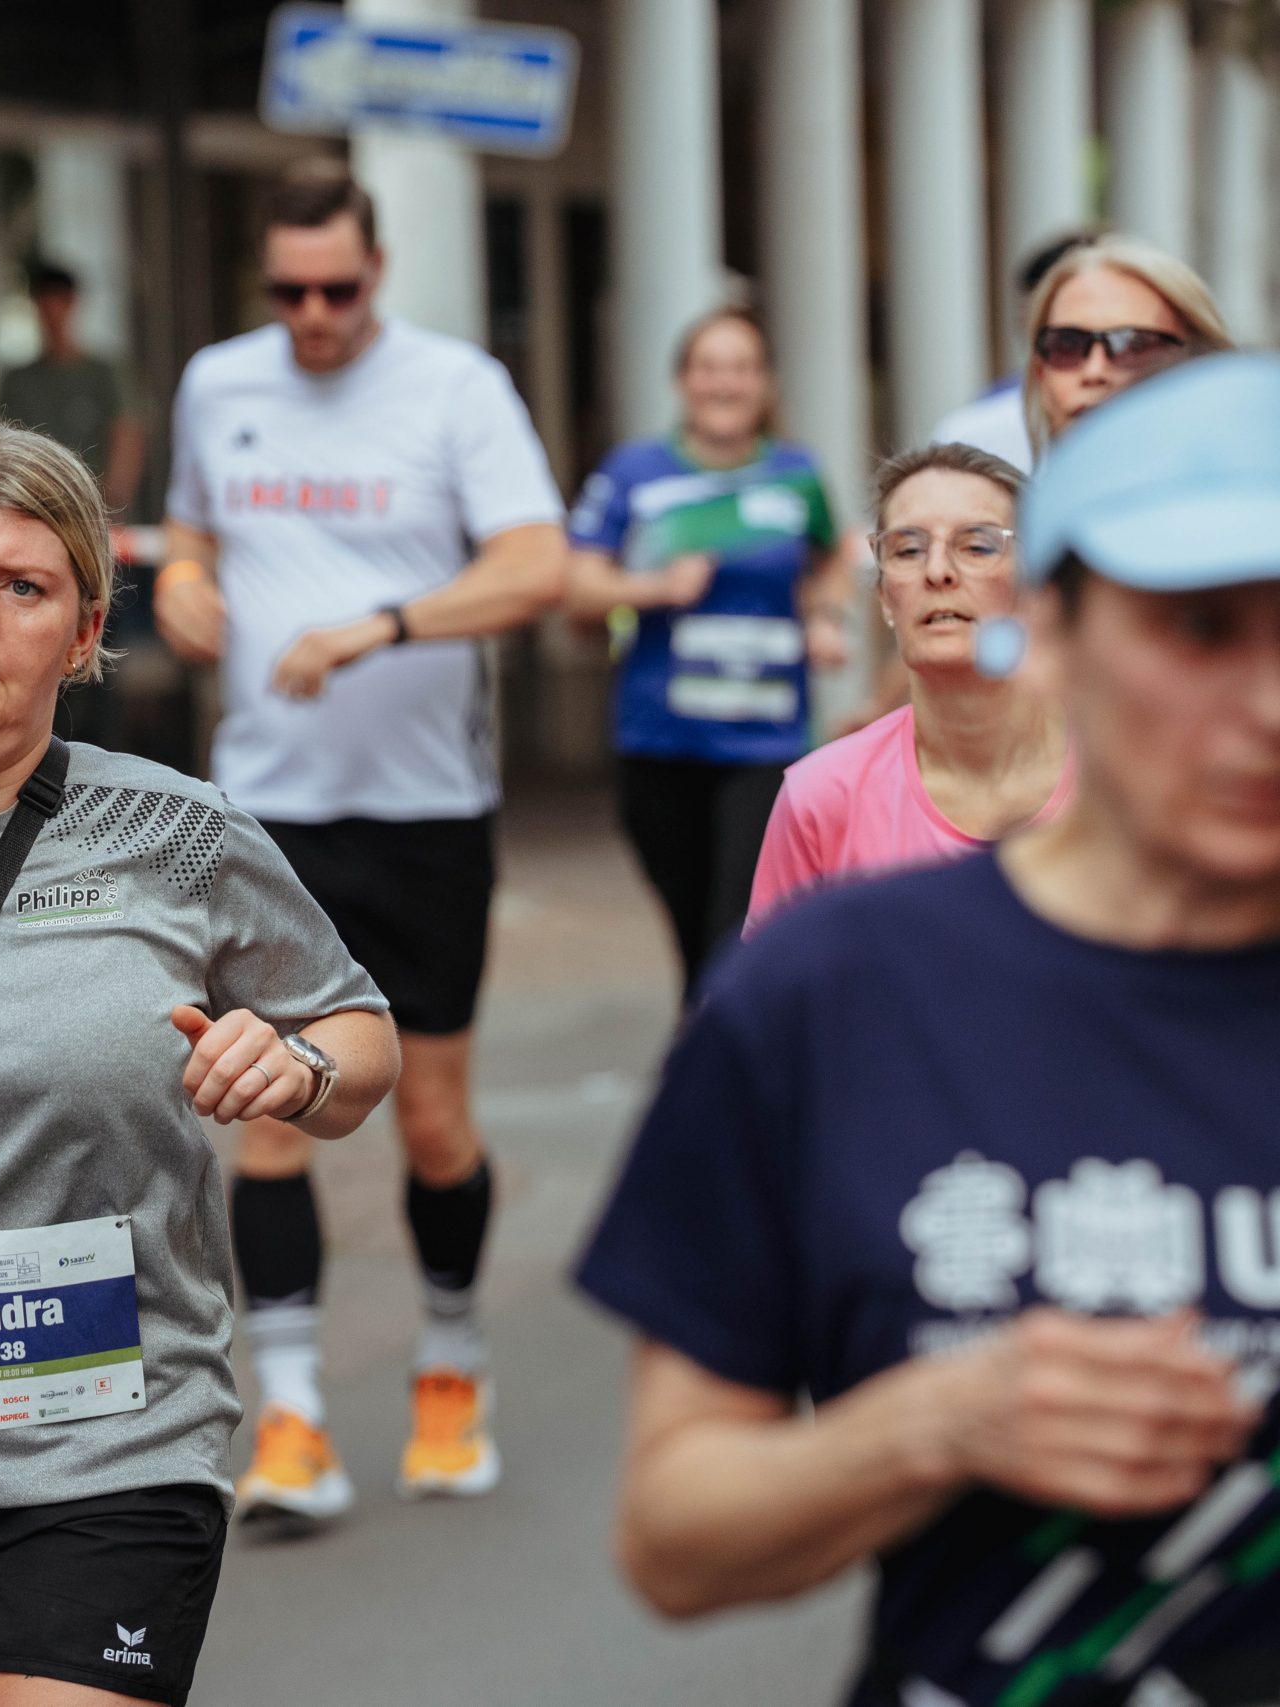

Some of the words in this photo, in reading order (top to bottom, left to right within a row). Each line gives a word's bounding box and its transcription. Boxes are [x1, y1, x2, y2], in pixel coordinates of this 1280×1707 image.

[75, 868, 118, 906] TEAMSPORT
[17, 886, 100, 913] Philipp
[20, 1366, 34, 1375] UHR
[2, 1395, 30, 1405] BOSCH
[103, 1646, 153, 1669] erima
